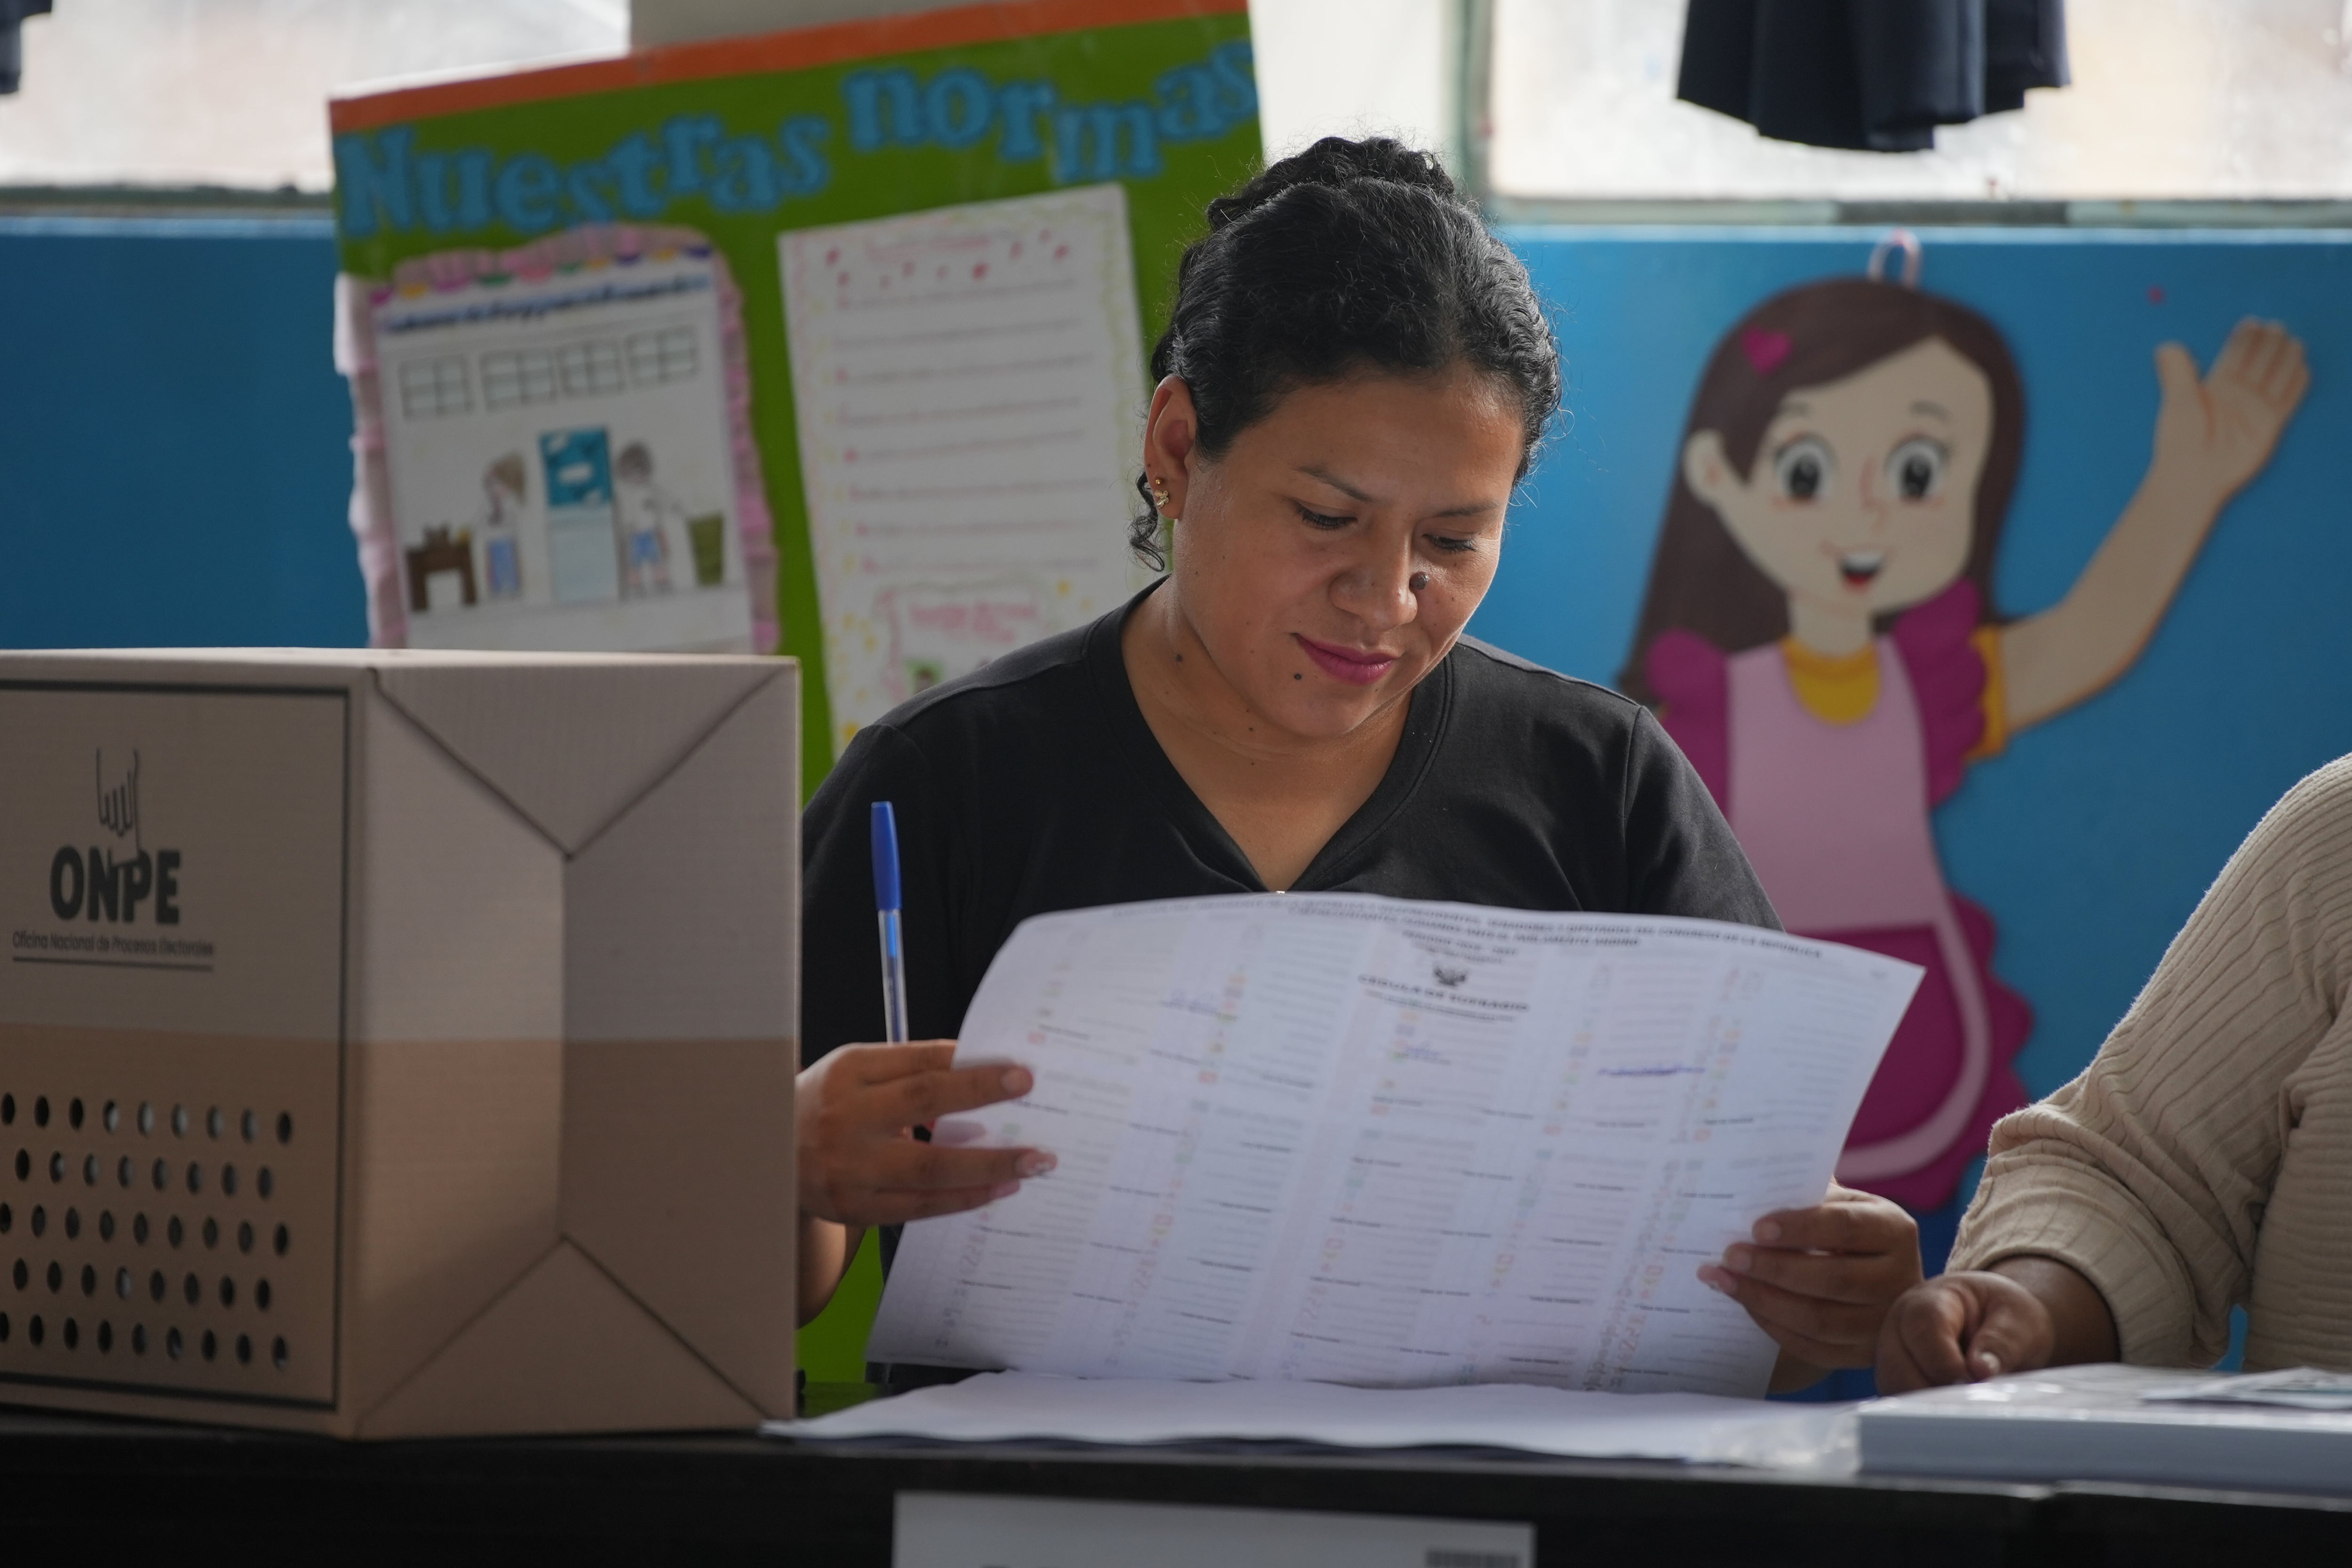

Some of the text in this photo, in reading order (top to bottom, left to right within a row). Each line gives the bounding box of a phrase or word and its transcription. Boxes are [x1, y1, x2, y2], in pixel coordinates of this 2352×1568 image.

[333, 40, 1259, 238] Nuestras normas
[50, 845, 181, 925] ONPE
[12, 931, 214, 957] Oficina Nacional de Procesos Electorales
